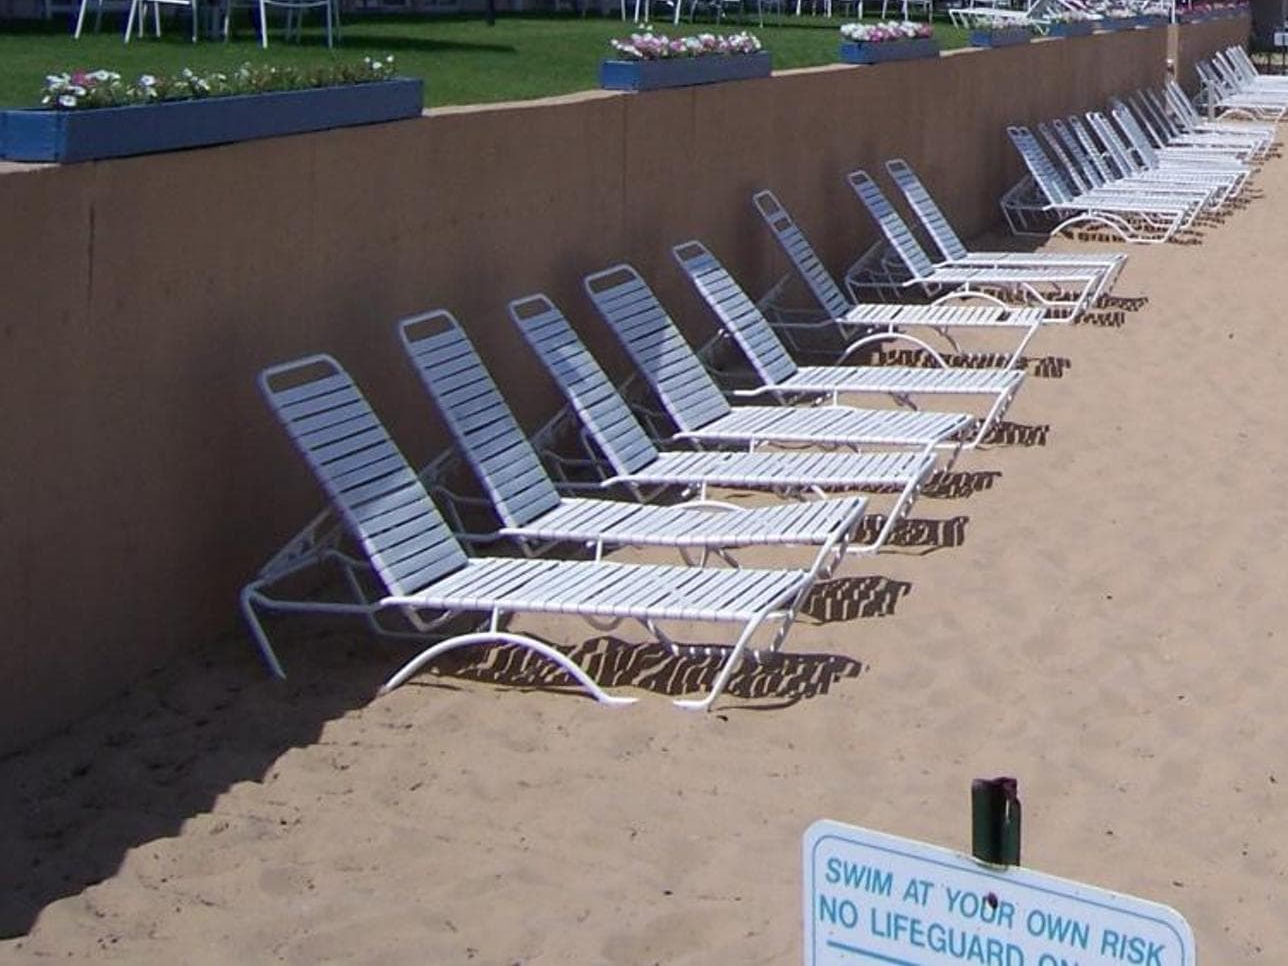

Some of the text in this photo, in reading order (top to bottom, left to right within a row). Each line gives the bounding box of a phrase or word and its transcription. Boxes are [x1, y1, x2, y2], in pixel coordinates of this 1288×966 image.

[819, 894, 1025, 966] NO LIFEGUARD
[825, 857, 1166, 966] SWIM AT YOUR OWN RISK
